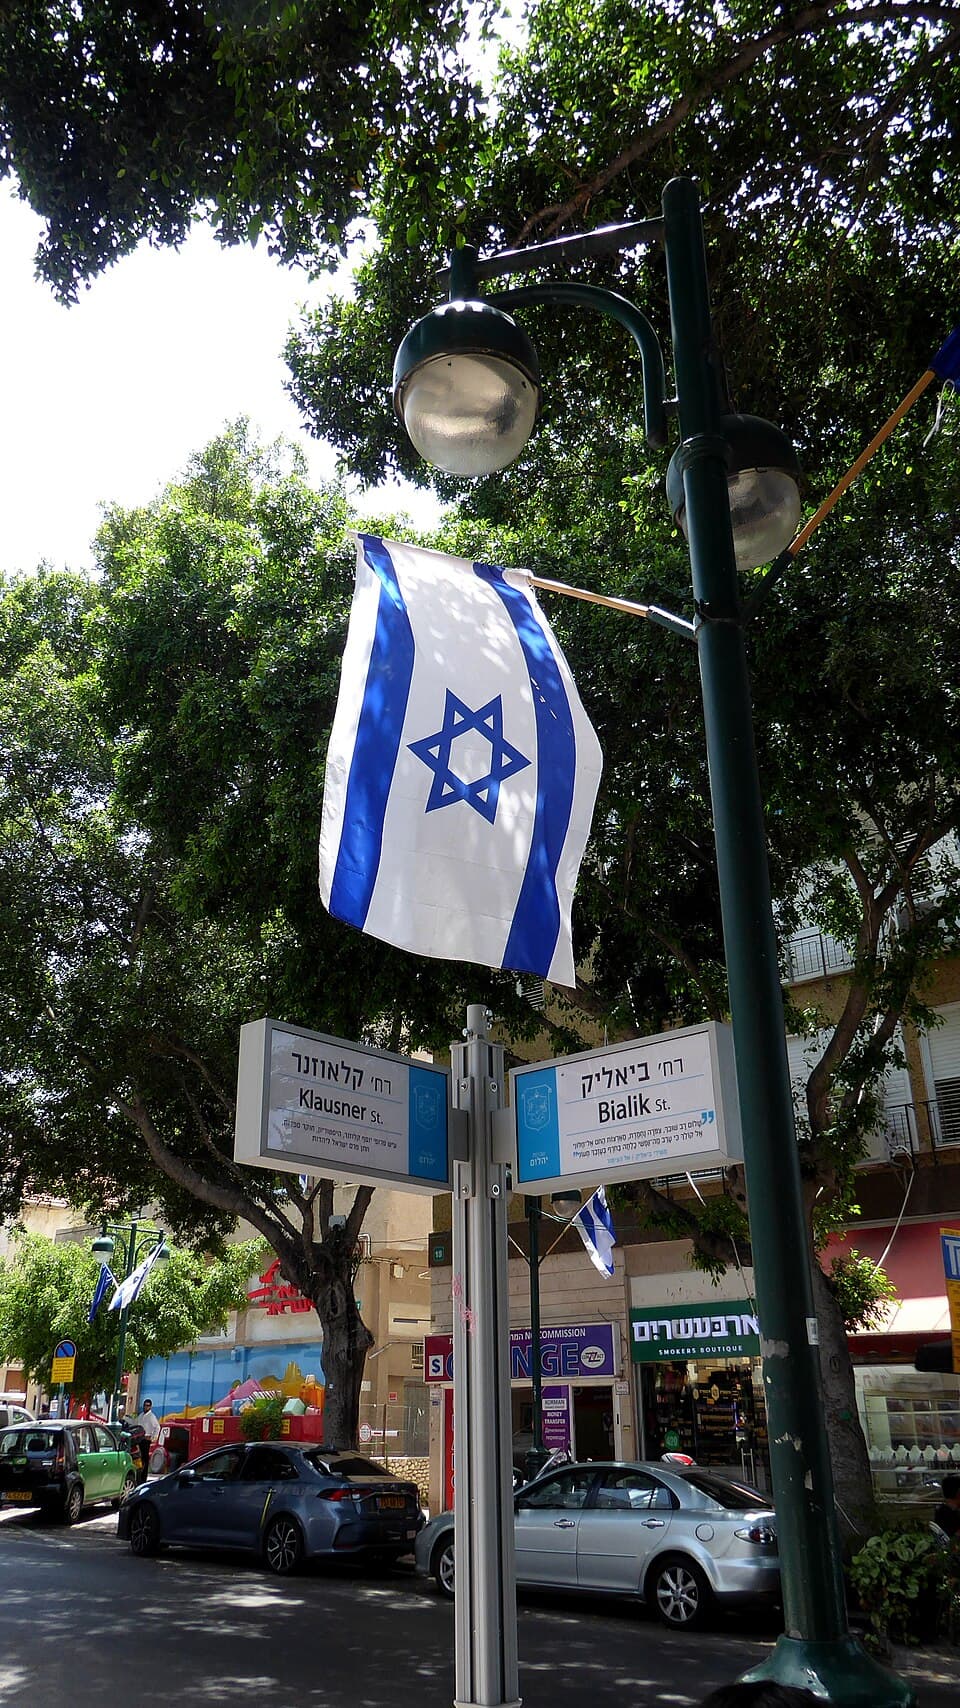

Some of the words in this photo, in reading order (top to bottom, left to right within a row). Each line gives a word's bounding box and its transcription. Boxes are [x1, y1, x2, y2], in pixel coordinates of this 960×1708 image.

[291, 1052, 364, 1091] קלאוזנר
[581, 1062, 650, 1099] ביאליק
[299, 1086, 367, 1121] Klausner
[370, 1110, 384, 1125] St.
[598, 1092, 651, 1124] Bialik
[655, 1098, 671, 1113] St.
[658, 1347, 697, 1356] SMOKERS
[700, 1344, 743, 1354] BOUTIQUE
